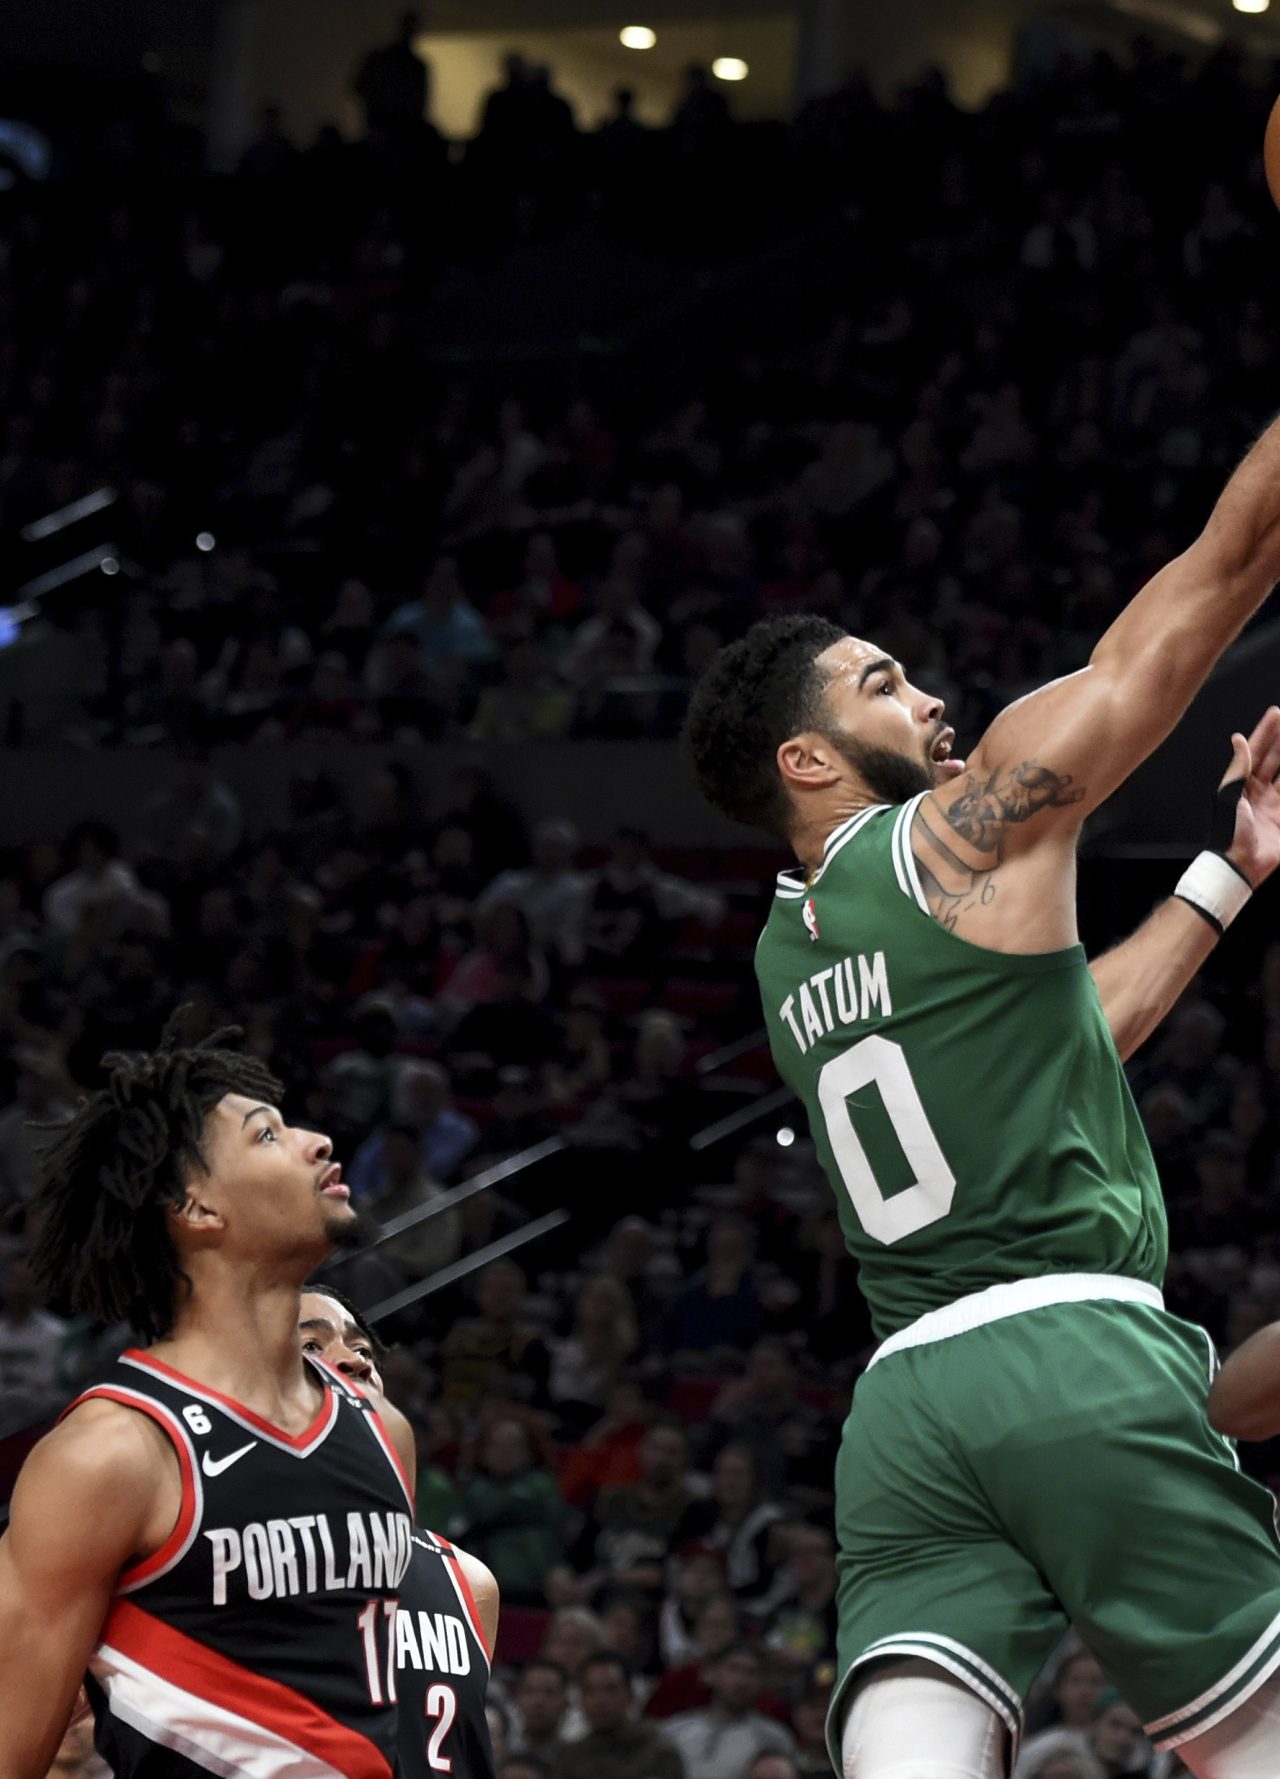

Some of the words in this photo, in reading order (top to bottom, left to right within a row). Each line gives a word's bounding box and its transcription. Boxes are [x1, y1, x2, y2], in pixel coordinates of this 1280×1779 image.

[779, 951, 893, 1055] TATUM
[818, 1034, 957, 1246] 0
[183, 1404, 212, 1435] 6
[203, 1512, 412, 1606] PORTLAND
[425, 1682, 456, 1773] 2
